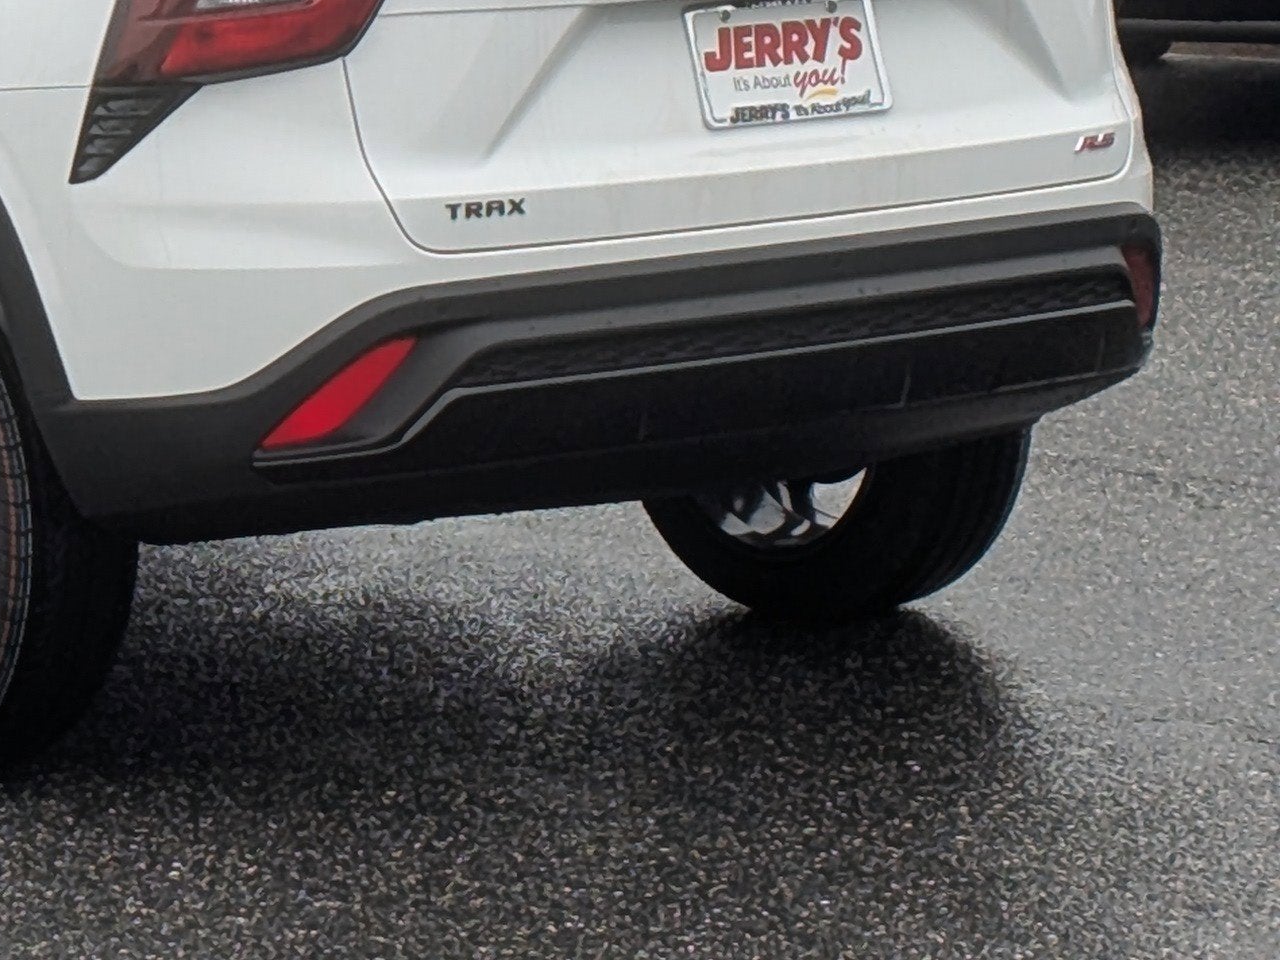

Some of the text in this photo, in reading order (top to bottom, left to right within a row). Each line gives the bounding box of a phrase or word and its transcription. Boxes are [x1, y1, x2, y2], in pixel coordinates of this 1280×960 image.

[704, 16, 863, 72] JERRY'S
[733, 76, 750, 91] It's
[752, 73, 791, 90] About
[445, 198, 525, 220] TRAX
